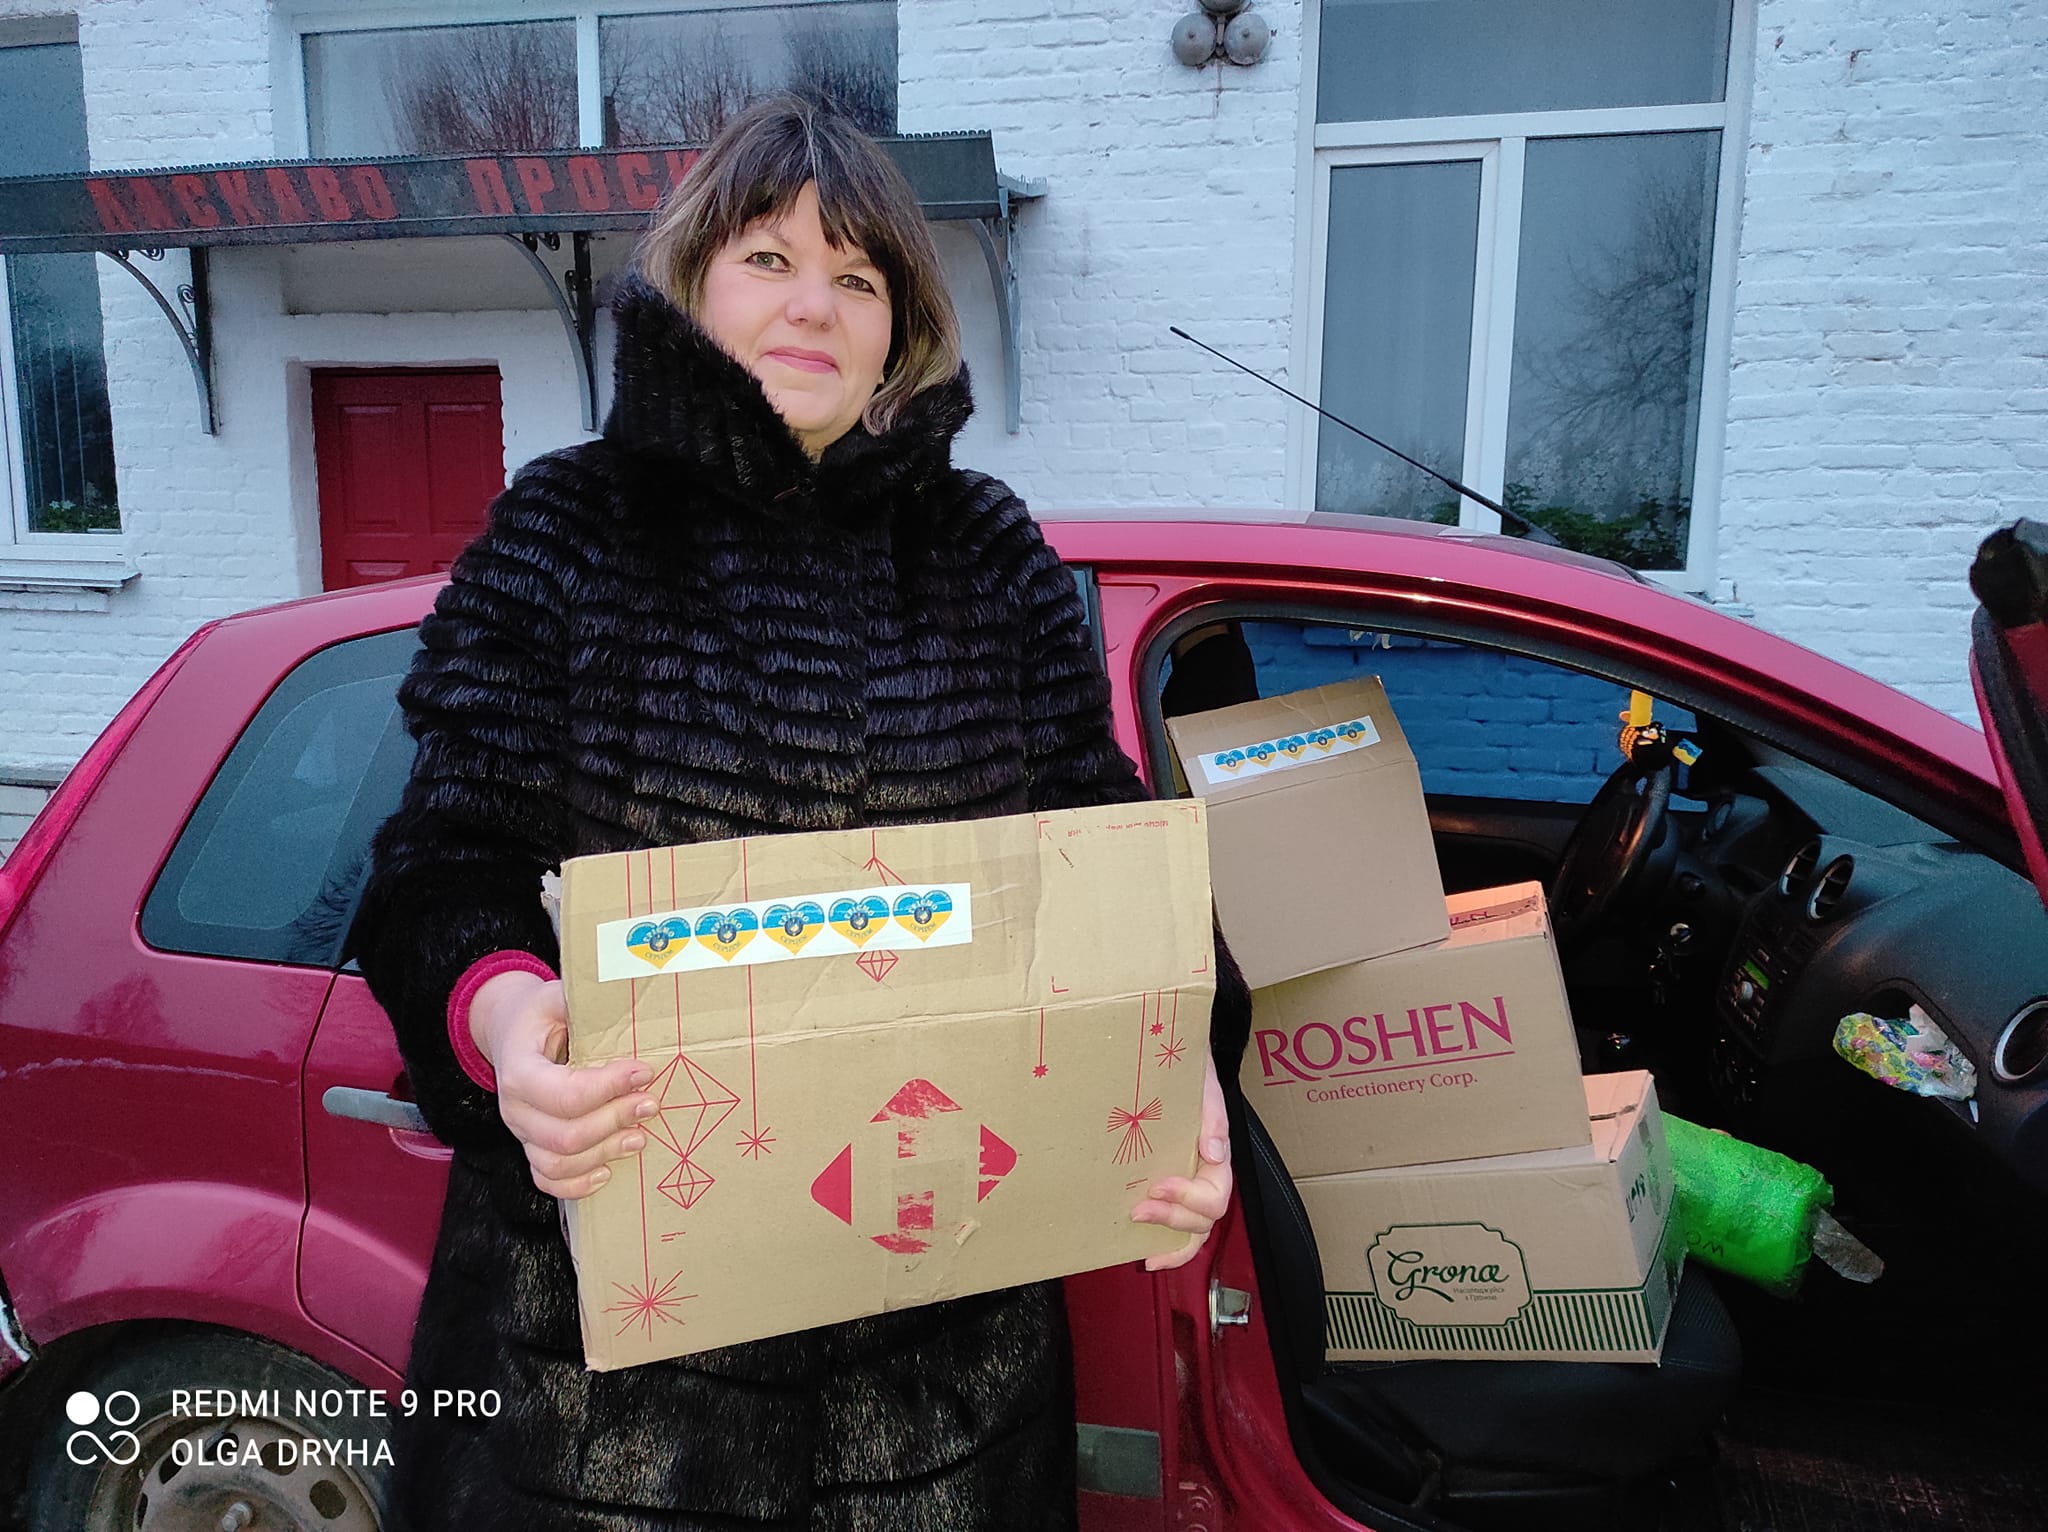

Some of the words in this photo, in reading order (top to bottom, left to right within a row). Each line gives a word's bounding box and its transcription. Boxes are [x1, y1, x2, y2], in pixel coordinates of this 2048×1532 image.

[86, 164, 398, 234] ЛАСКАВО
[1254, 996, 1513, 1082] ROSHEN
[1306, 1078, 1425, 1103] Confectionery
[1429, 1071, 1479, 1090] Corp.
[1387, 1250, 1510, 1303] Grona
